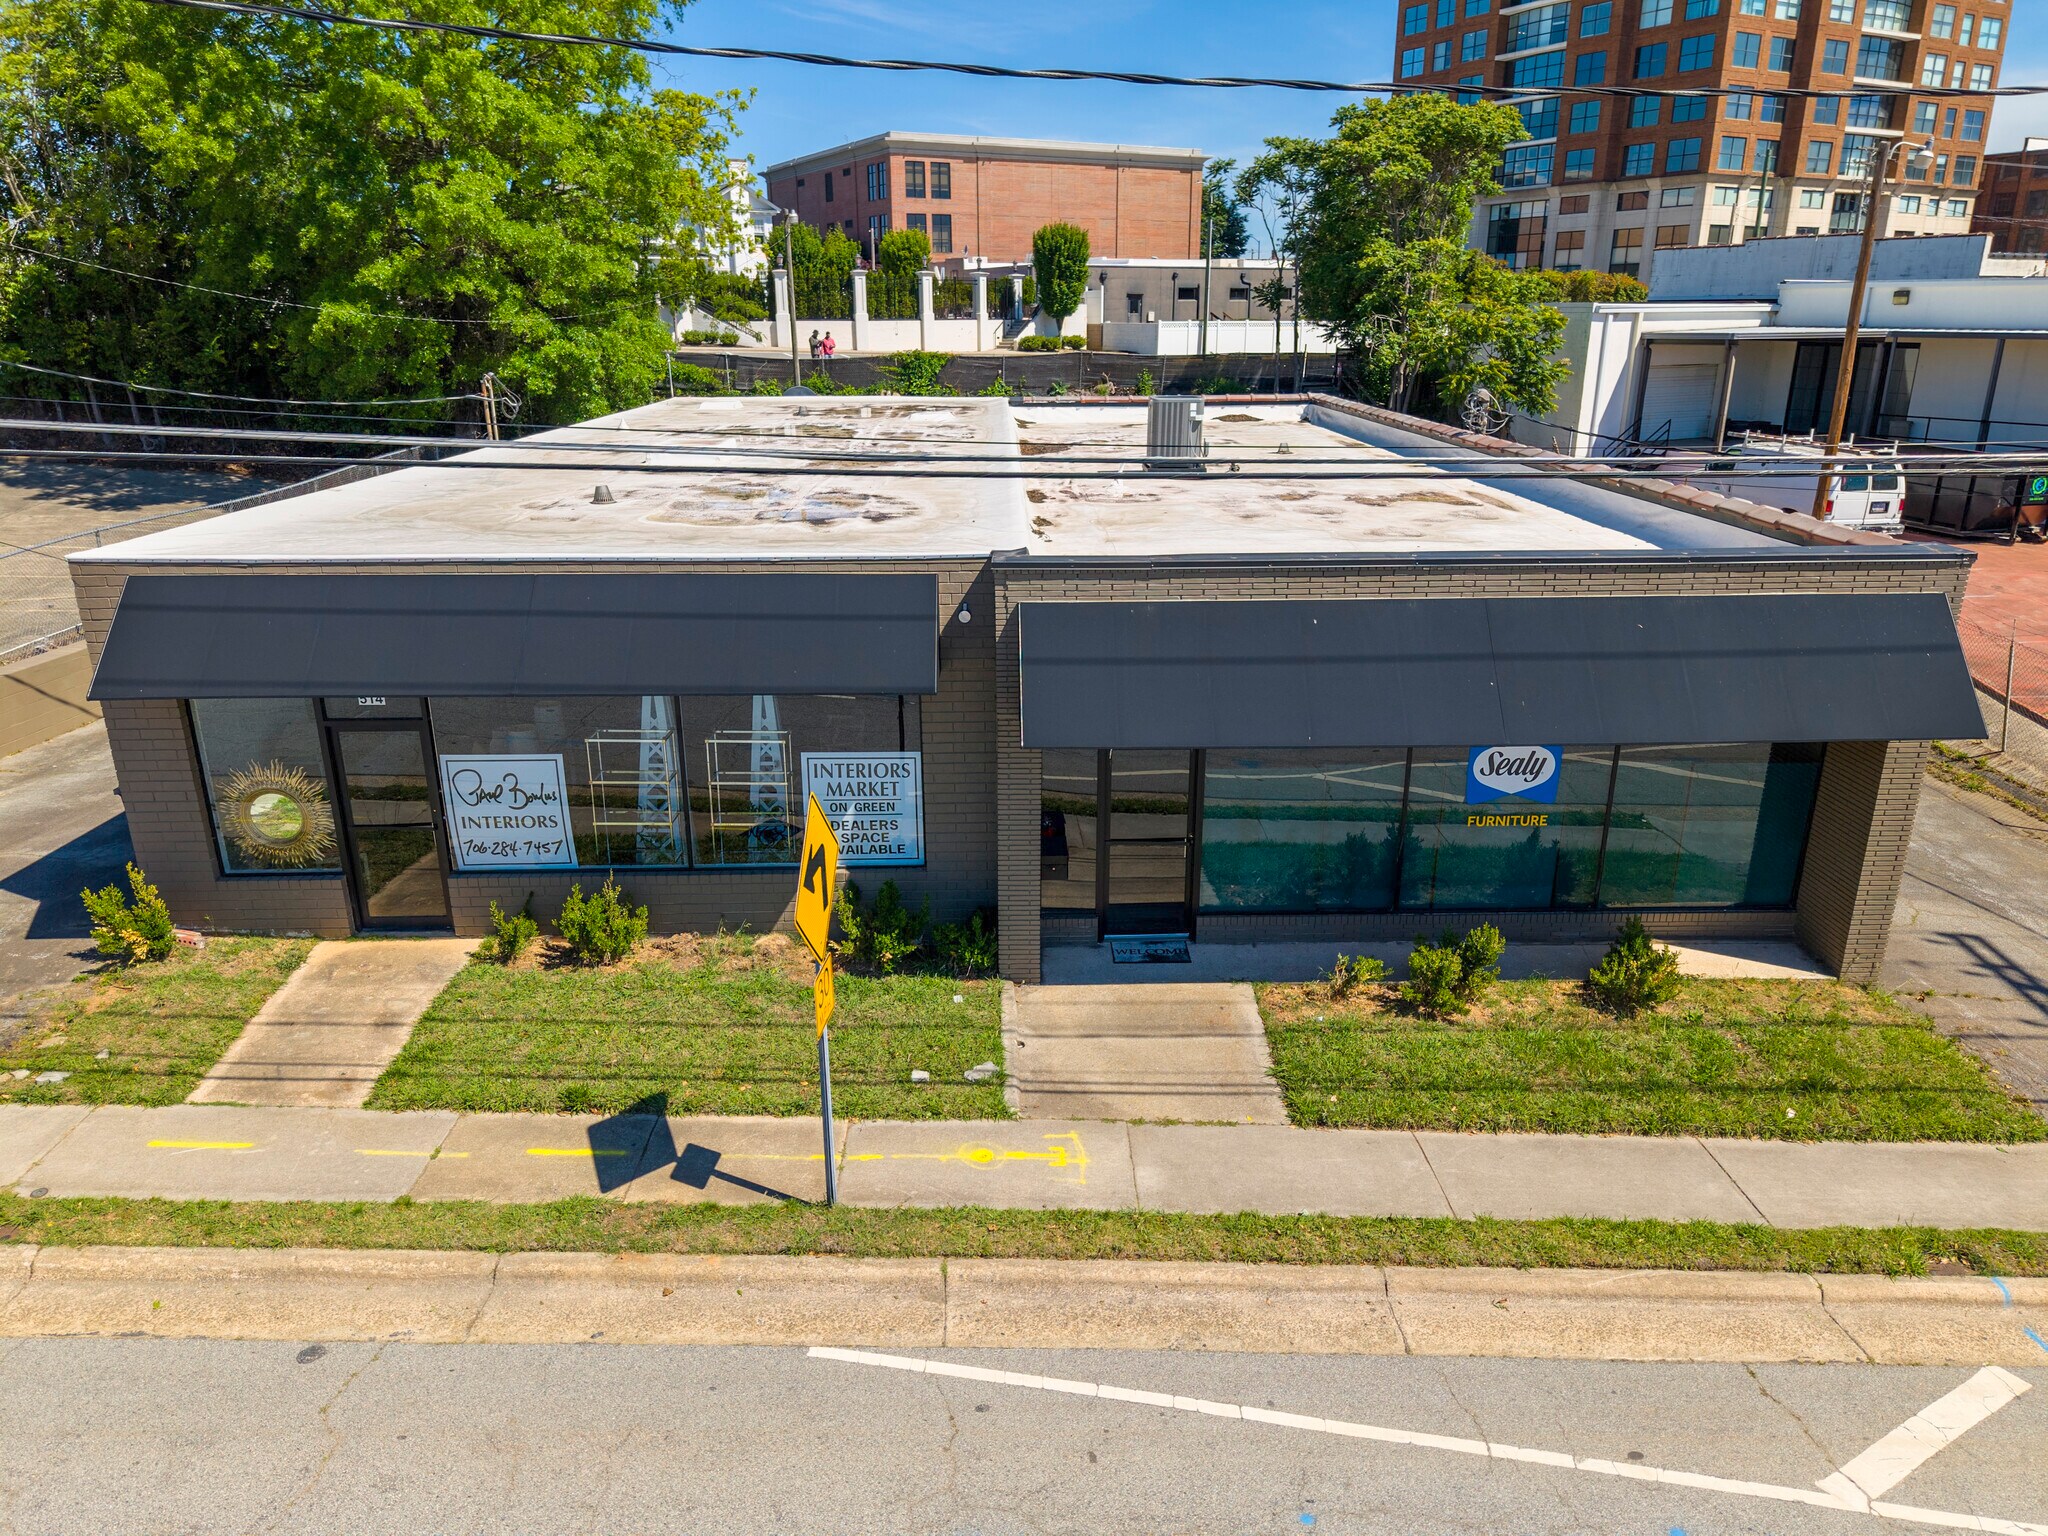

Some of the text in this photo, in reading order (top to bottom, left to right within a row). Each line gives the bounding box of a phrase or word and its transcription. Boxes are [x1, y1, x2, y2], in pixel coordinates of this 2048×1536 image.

[813, 762, 911, 779] INTERIORS
[1479, 750, 1548, 783] Sealy
[826, 781, 899, 797] MARKET
[829, 801, 895, 813] ON GREEN
[461, 814, 558, 829] INTERIORS
[831, 820, 899, 831] DEALERS
[1467, 815, 1549, 828] FURNITURE
[841, 832, 890, 843] SPACE
[838, 843, 907, 855] VAILABLE
